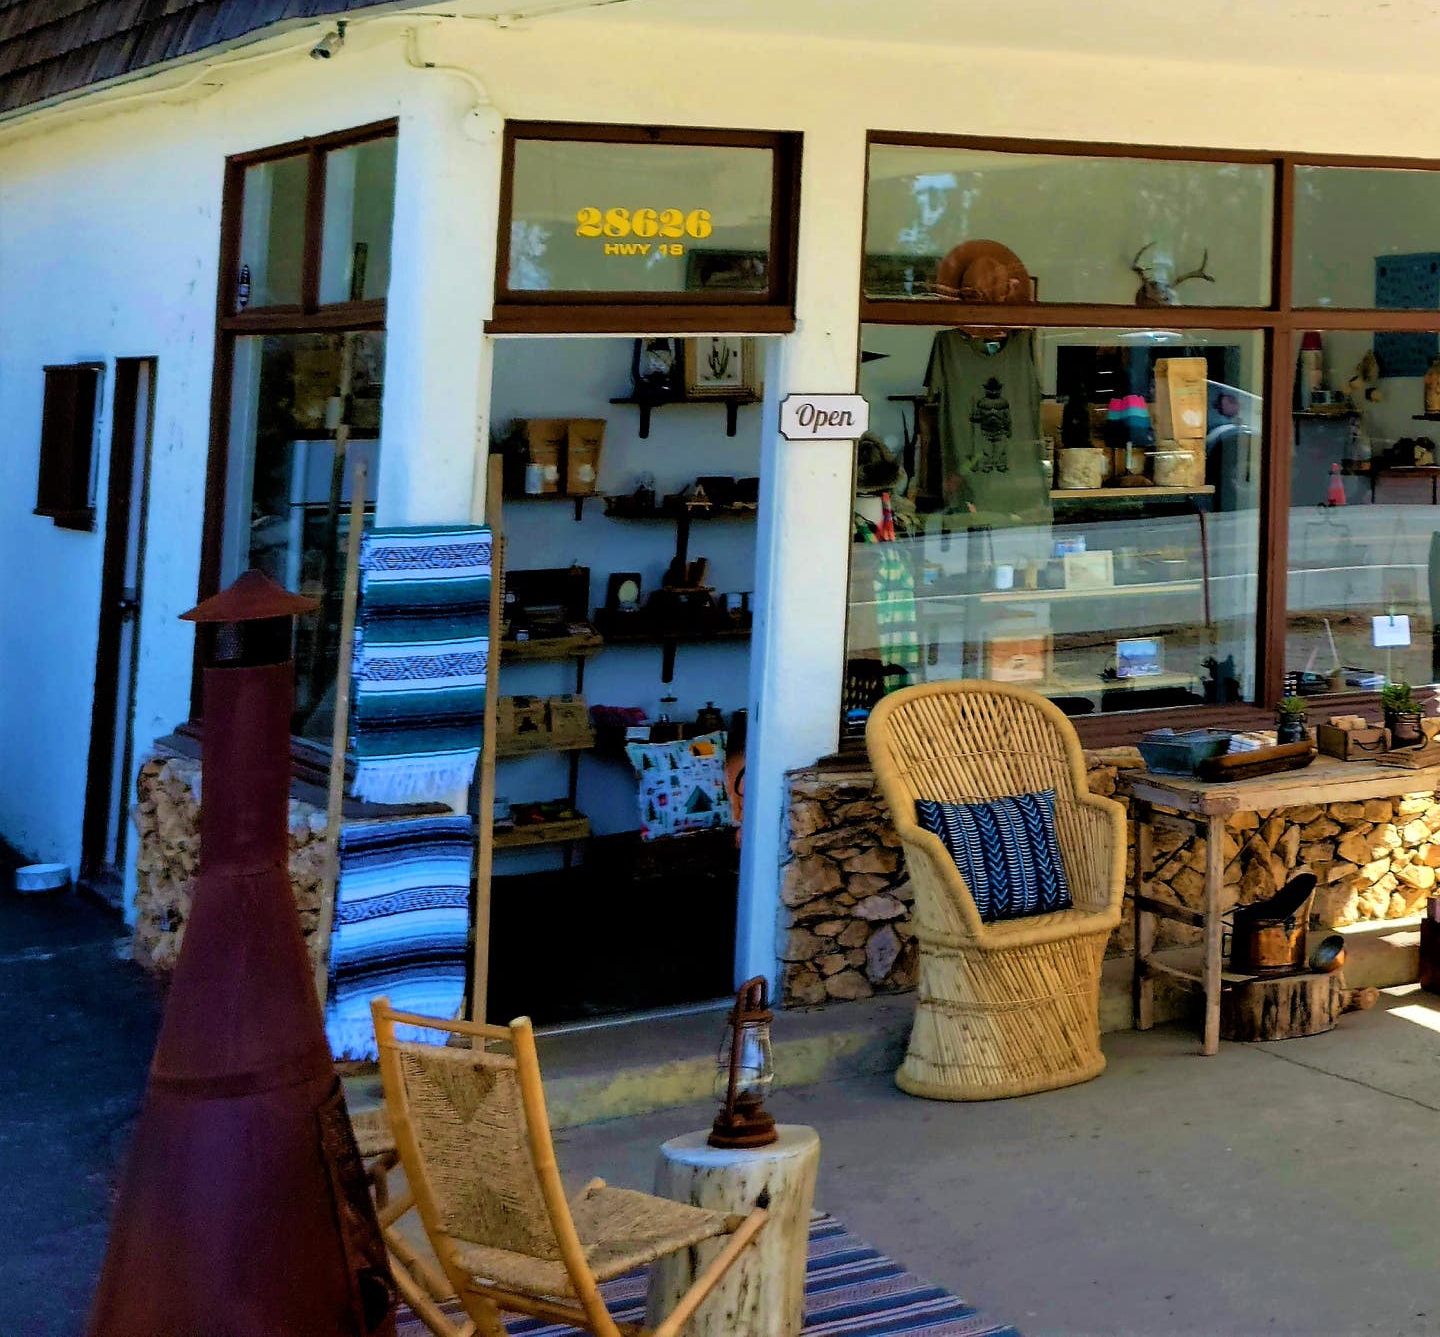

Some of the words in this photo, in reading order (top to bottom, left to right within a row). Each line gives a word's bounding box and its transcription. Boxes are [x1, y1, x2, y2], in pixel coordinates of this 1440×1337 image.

[575, 207, 713, 239] 28626
[603, 243, 651, 256] HWY
[658, 243, 685, 257] 18
[795, 403, 856, 434] Open
